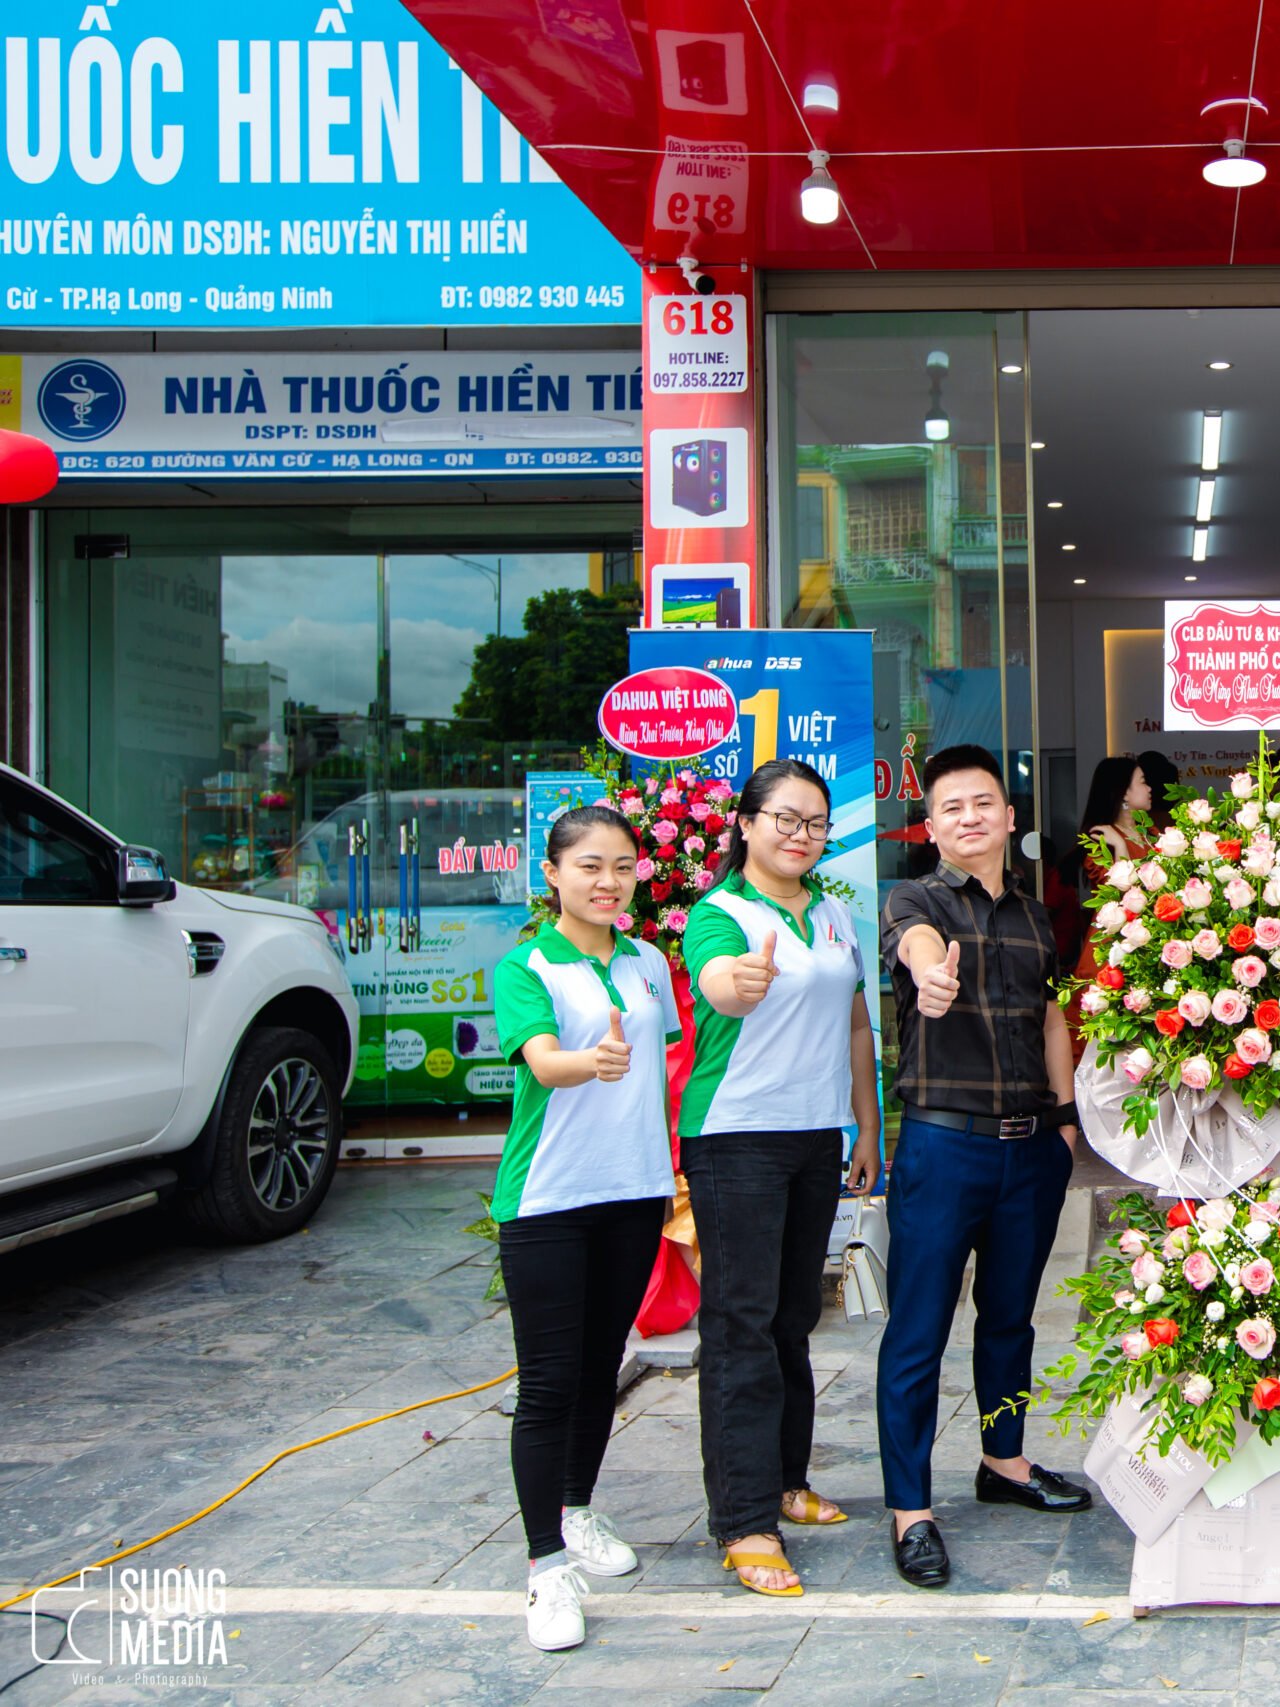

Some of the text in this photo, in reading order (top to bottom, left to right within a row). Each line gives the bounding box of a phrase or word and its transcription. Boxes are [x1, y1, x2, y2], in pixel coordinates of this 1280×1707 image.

[103, 212, 173, 255] MÔN
[183, 220, 271, 255] DSĐH:
[280, 207, 397, 255] NGUYỄN
[406, 220, 451, 262] THỊ
[6, 286, 38, 310] Cừ
[60, 287, 121, 316] TP.Hạ
[128, 288, 182, 312] Long
[205, 285, 274, 312] Quảng
[282, 286, 333, 309] Ninh
[440, 286, 473, 308] ĐT:
[479, 286, 533, 308] 0982
[539, 286, 578, 307] 930
[585, 286, 624, 307] 445
[662, 300, 735, 336] 618
[668, 351, 729, 365] HOTLINE:
[164, 363, 570, 415] NHÀ THUỐC HIỀN
[652, 371, 745, 388] 097.858.2227
[245, 424, 376, 440] DSPT: DSĐH
[63, 456, 99, 469] ĐC:
[105, 456, 145, 468] 620
[152, 453, 226, 468] ĐƯỜNG
[233, 454, 275, 468] VĂN
[332, 455, 361, 470] HẠ
[367, 454, 423, 467] LONG
[444, 453, 474, 468] QN
[505, 453, 535, 466] ĐT:
[542, 453, 598, 466] 0982.
[1182, 626, 1204, 642] CLB
[1206, 619, 1233, 642] ĐẦU
[1235, 625, 1253, 642] TƯ
[1254, 626, 1265, 642] &
[764, 657, 803, 670] DSS
[1186, 647, 1236, 671] THÀNH
[1239, 644, 1269, 670] PHỐ
[611, 686, 728, 713] DAHUA VIỆT LONG
[1232, 672, 1259, 704] Khai
[639, 721, 658, 744] Khai
[788, 710, 837, 748] VIỆT
[714, 747, 743, 777] SỐ
[438, 836, 519, 875] ĐẨY VÀO
[431, 972, 472, 1004] Số
